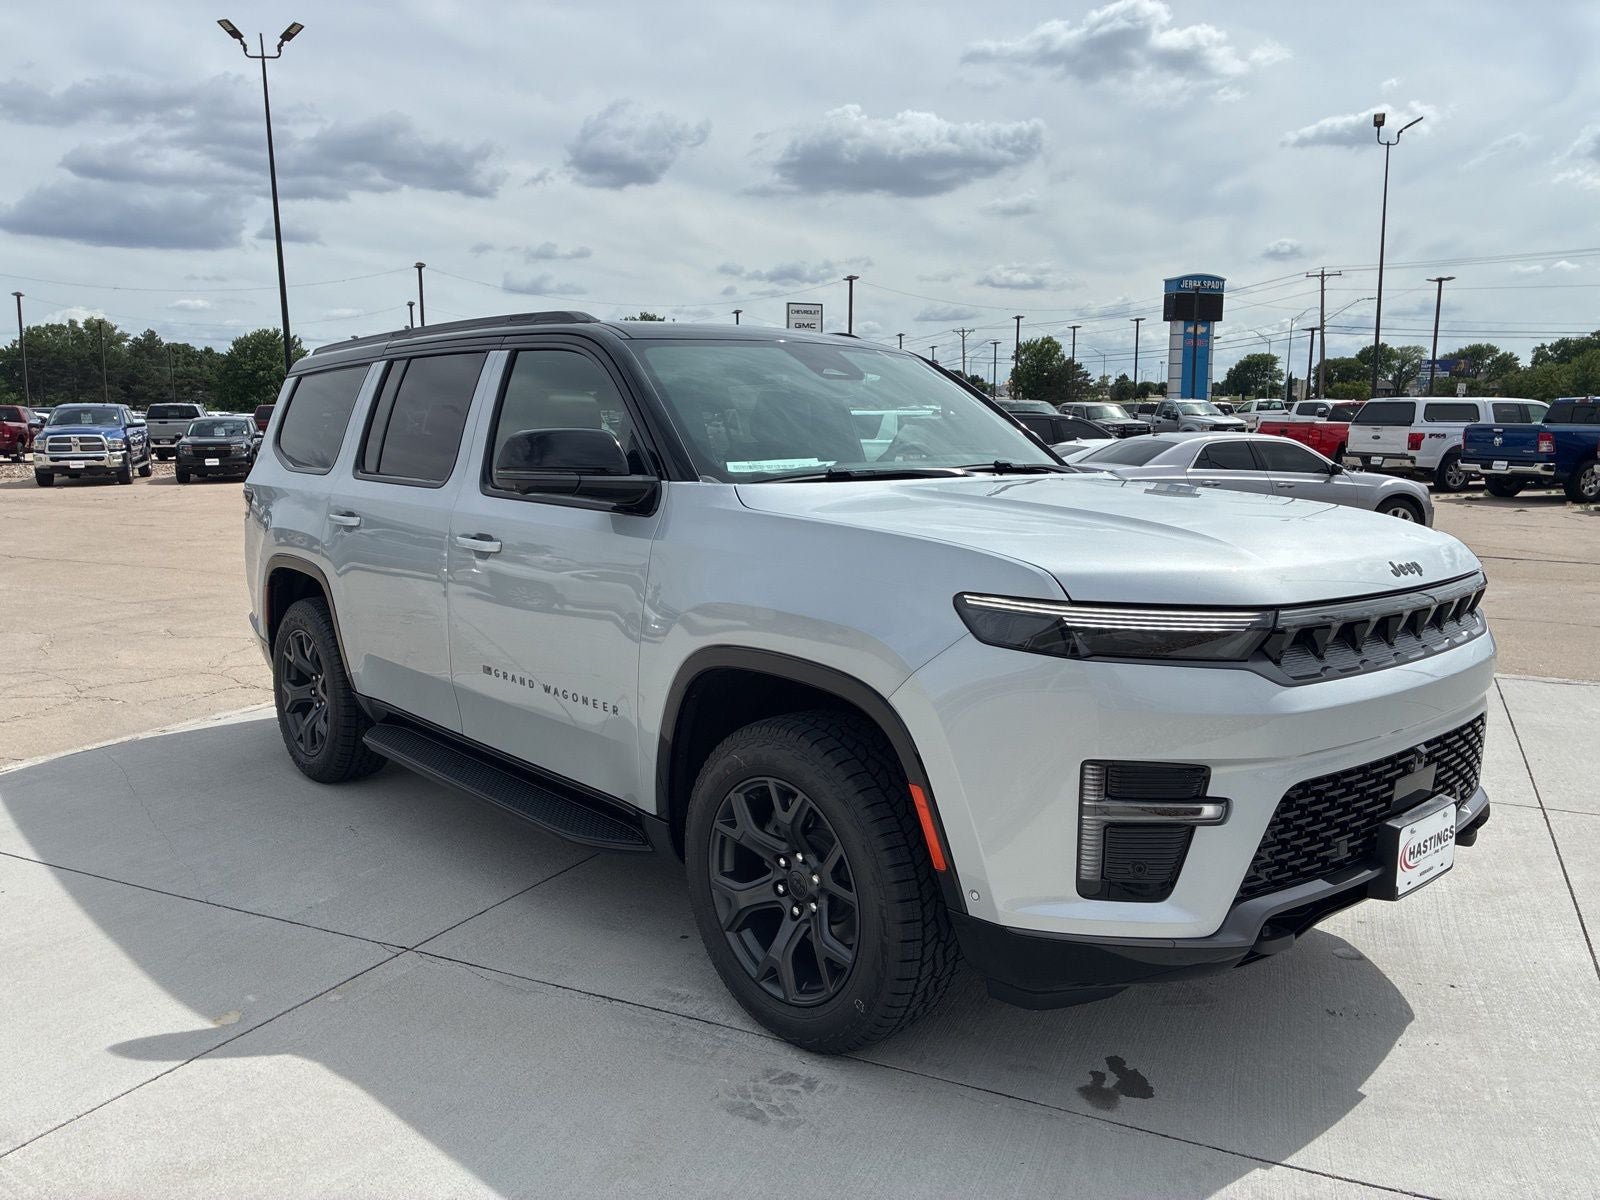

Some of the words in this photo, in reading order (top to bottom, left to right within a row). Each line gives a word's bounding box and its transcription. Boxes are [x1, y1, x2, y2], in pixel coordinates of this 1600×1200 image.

[1180, 279, 1201, 289] JERRY
[1202, 280, 1224, 289] SPADY
[1389, 561, 1423, 577] Jeep
[493, 668, 535, 689] GRAND
[542, 683, 619, 716] WAGONEER
[1408, 825, 1454, 861] HASTINGS
